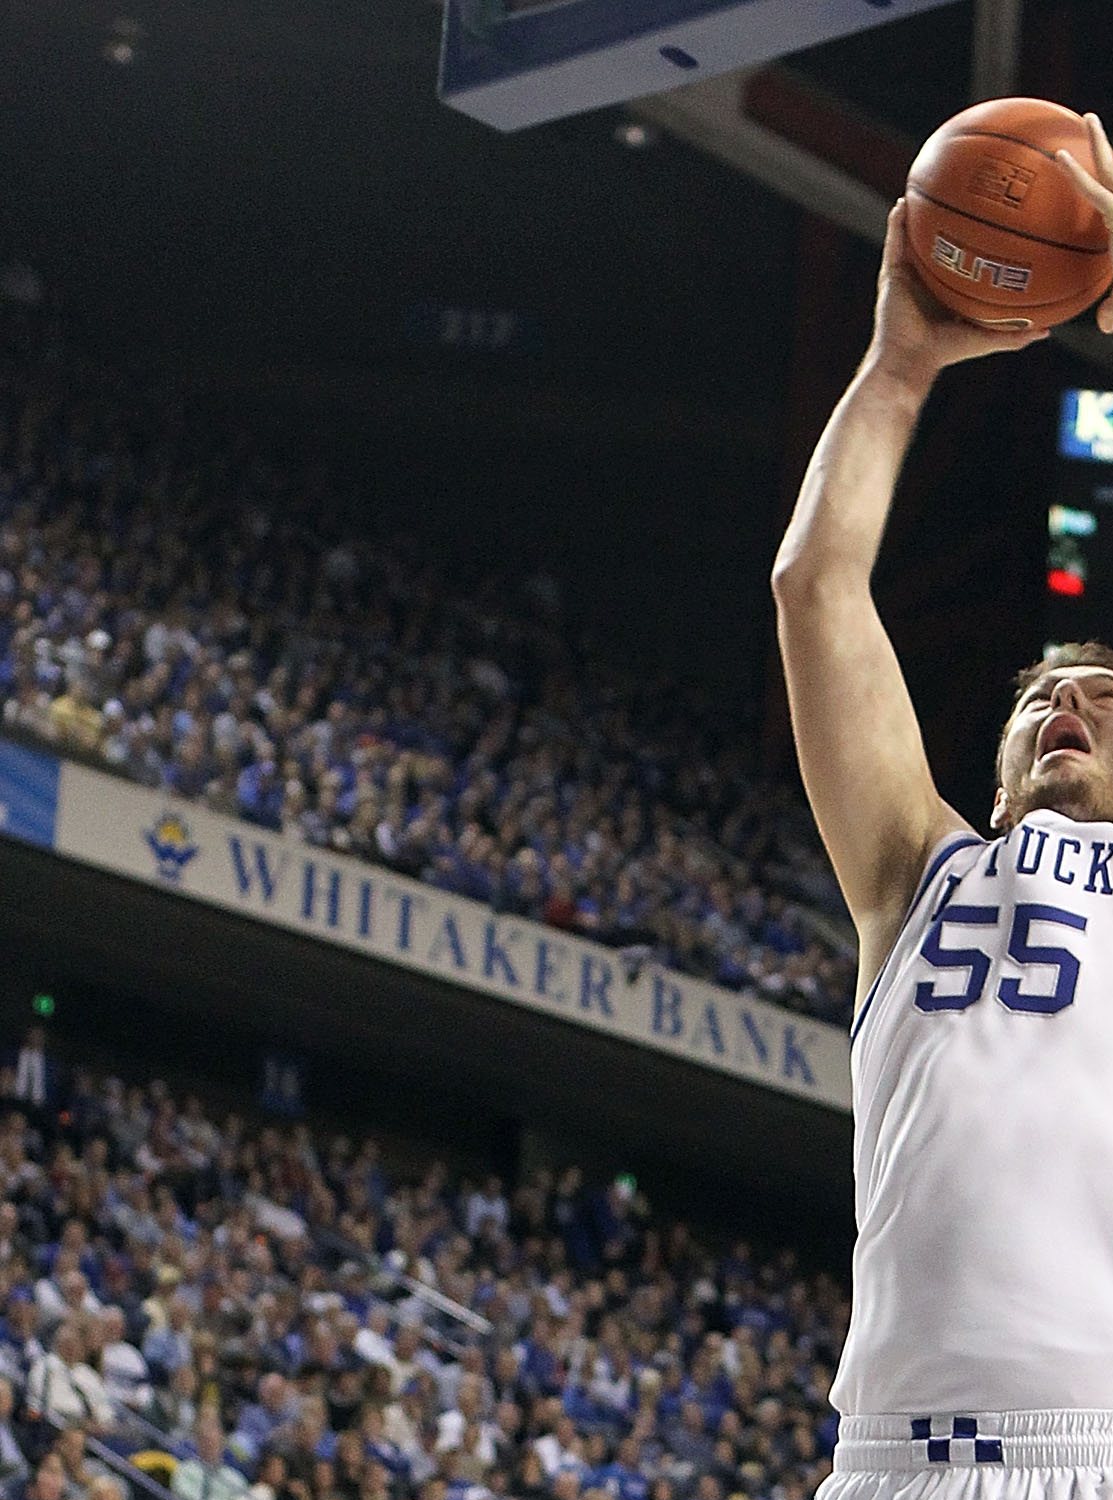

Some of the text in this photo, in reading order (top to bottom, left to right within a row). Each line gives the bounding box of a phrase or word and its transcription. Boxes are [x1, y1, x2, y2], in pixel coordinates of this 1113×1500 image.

[931, 234, 1033, 292] ELITE
[228, 835, 819, 1088] WHITAKER BANK
[914, 903, 1088, 1014] 55
